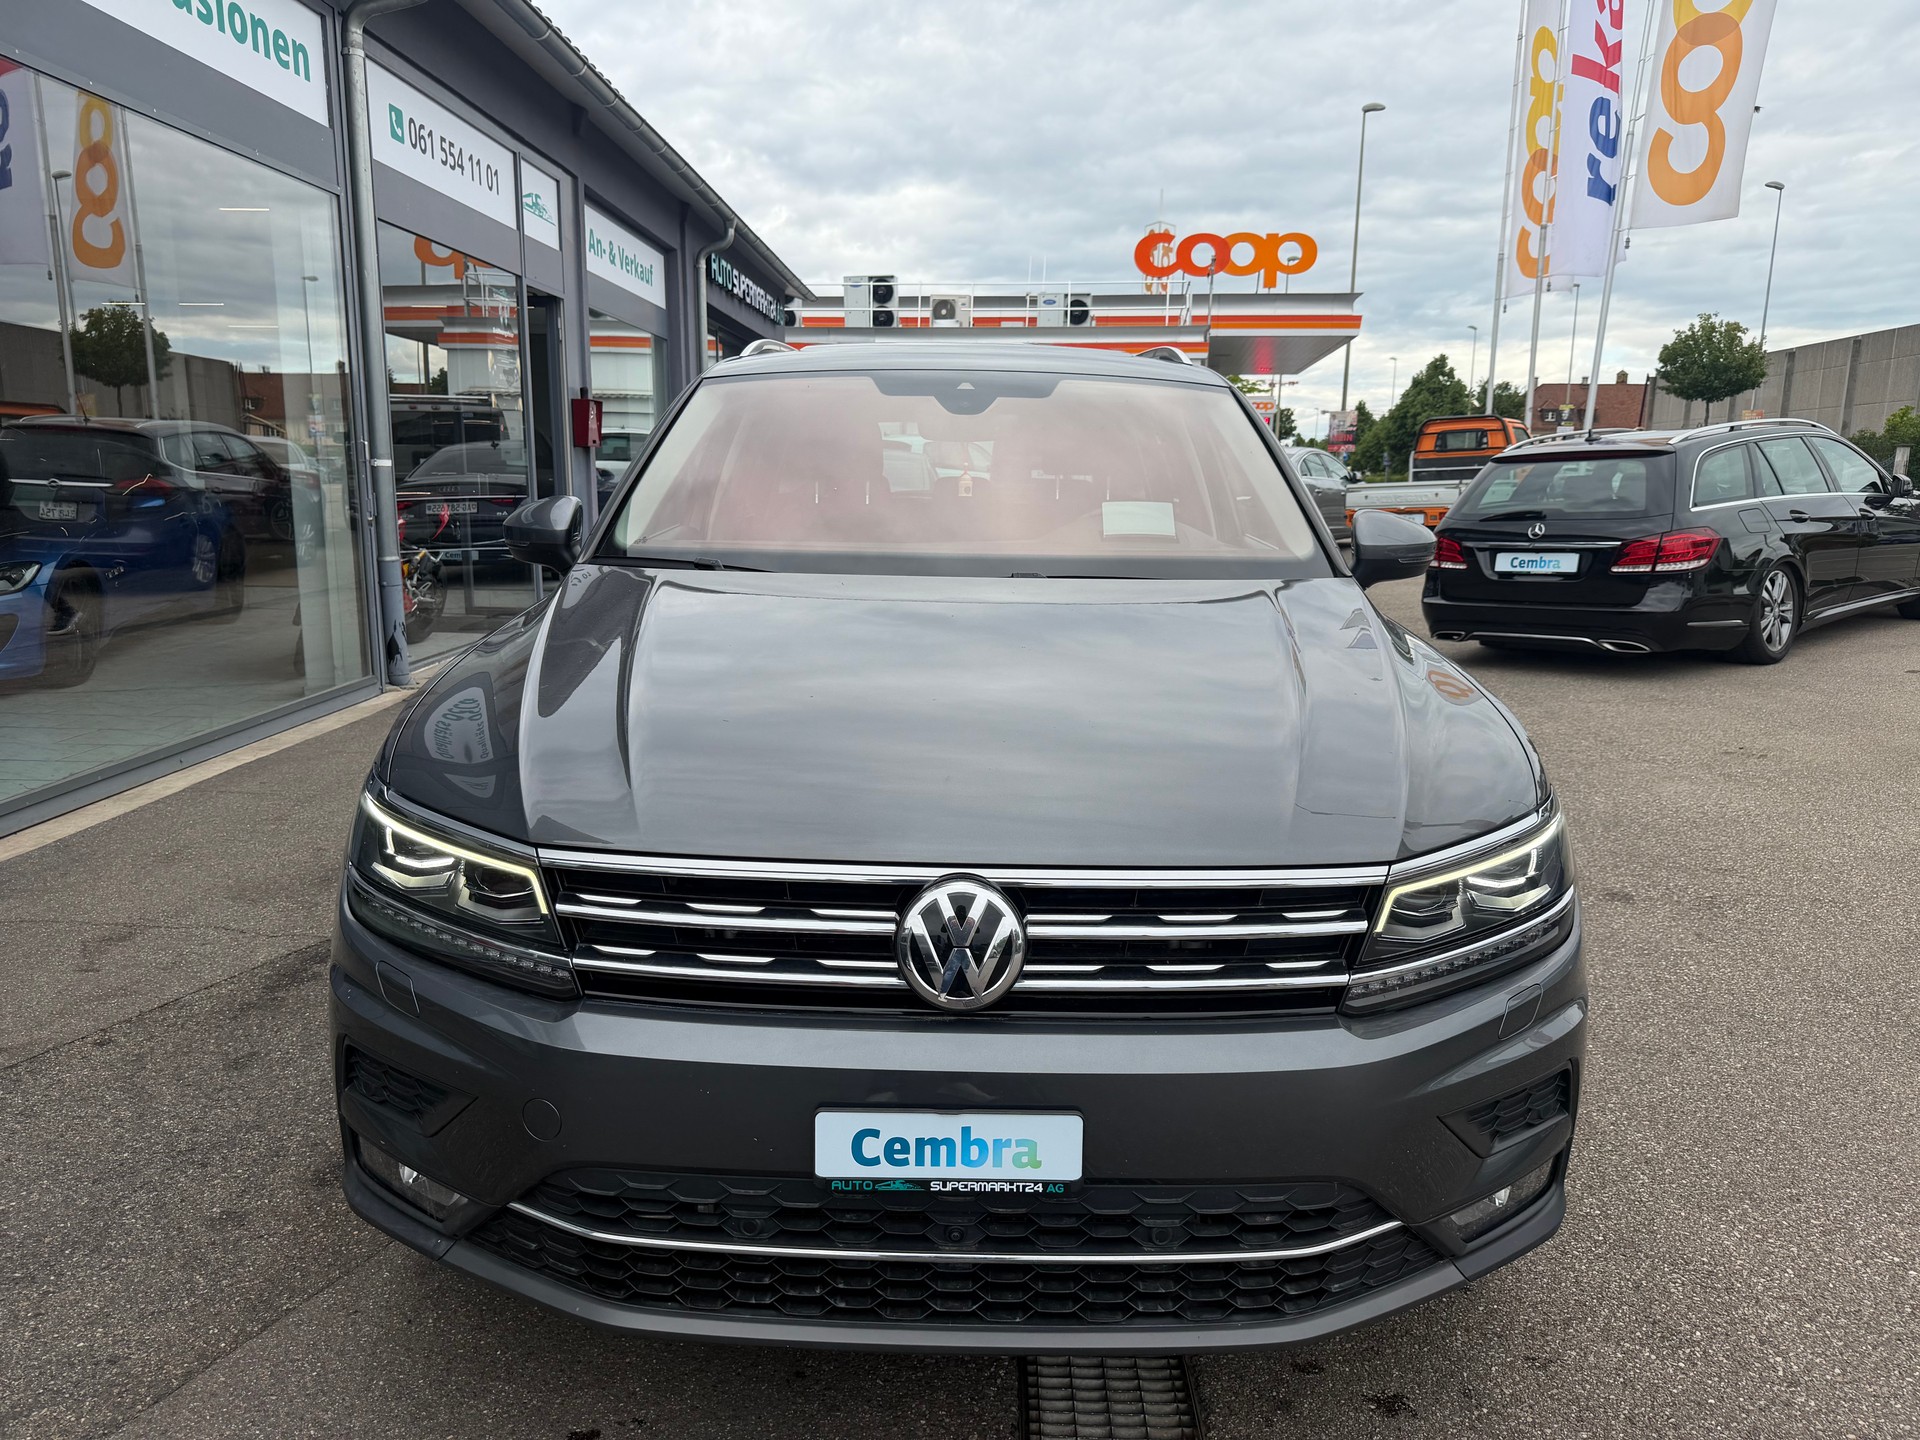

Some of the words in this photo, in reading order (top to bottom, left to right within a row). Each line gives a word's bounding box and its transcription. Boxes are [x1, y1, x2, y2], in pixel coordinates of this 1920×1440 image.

[408, 117, 435, 160] 061
[440, 135, 465, 176] 554
[468, 153, 482, 186] 11
[486, 163, 499, 196] 01
[1516, 26, 1564, 279] coop
[588, 228, 606, 259] An-
[608, 240, 617, 267] &
[617, 245, 653, 287] Verkauf
[711, 252, 733, 291] AUTO
[1134, 232, 1318, 288] coop
[1510, 556, 1561, 569] Cembra
[850, 1125, 1042, 1170] Cembra
[831, 1180, 873, 1191] AUTO
[930, 1181, 1044, 1193] SUPERMARKT24
[1046, 1183, 1065, 1193] AG
